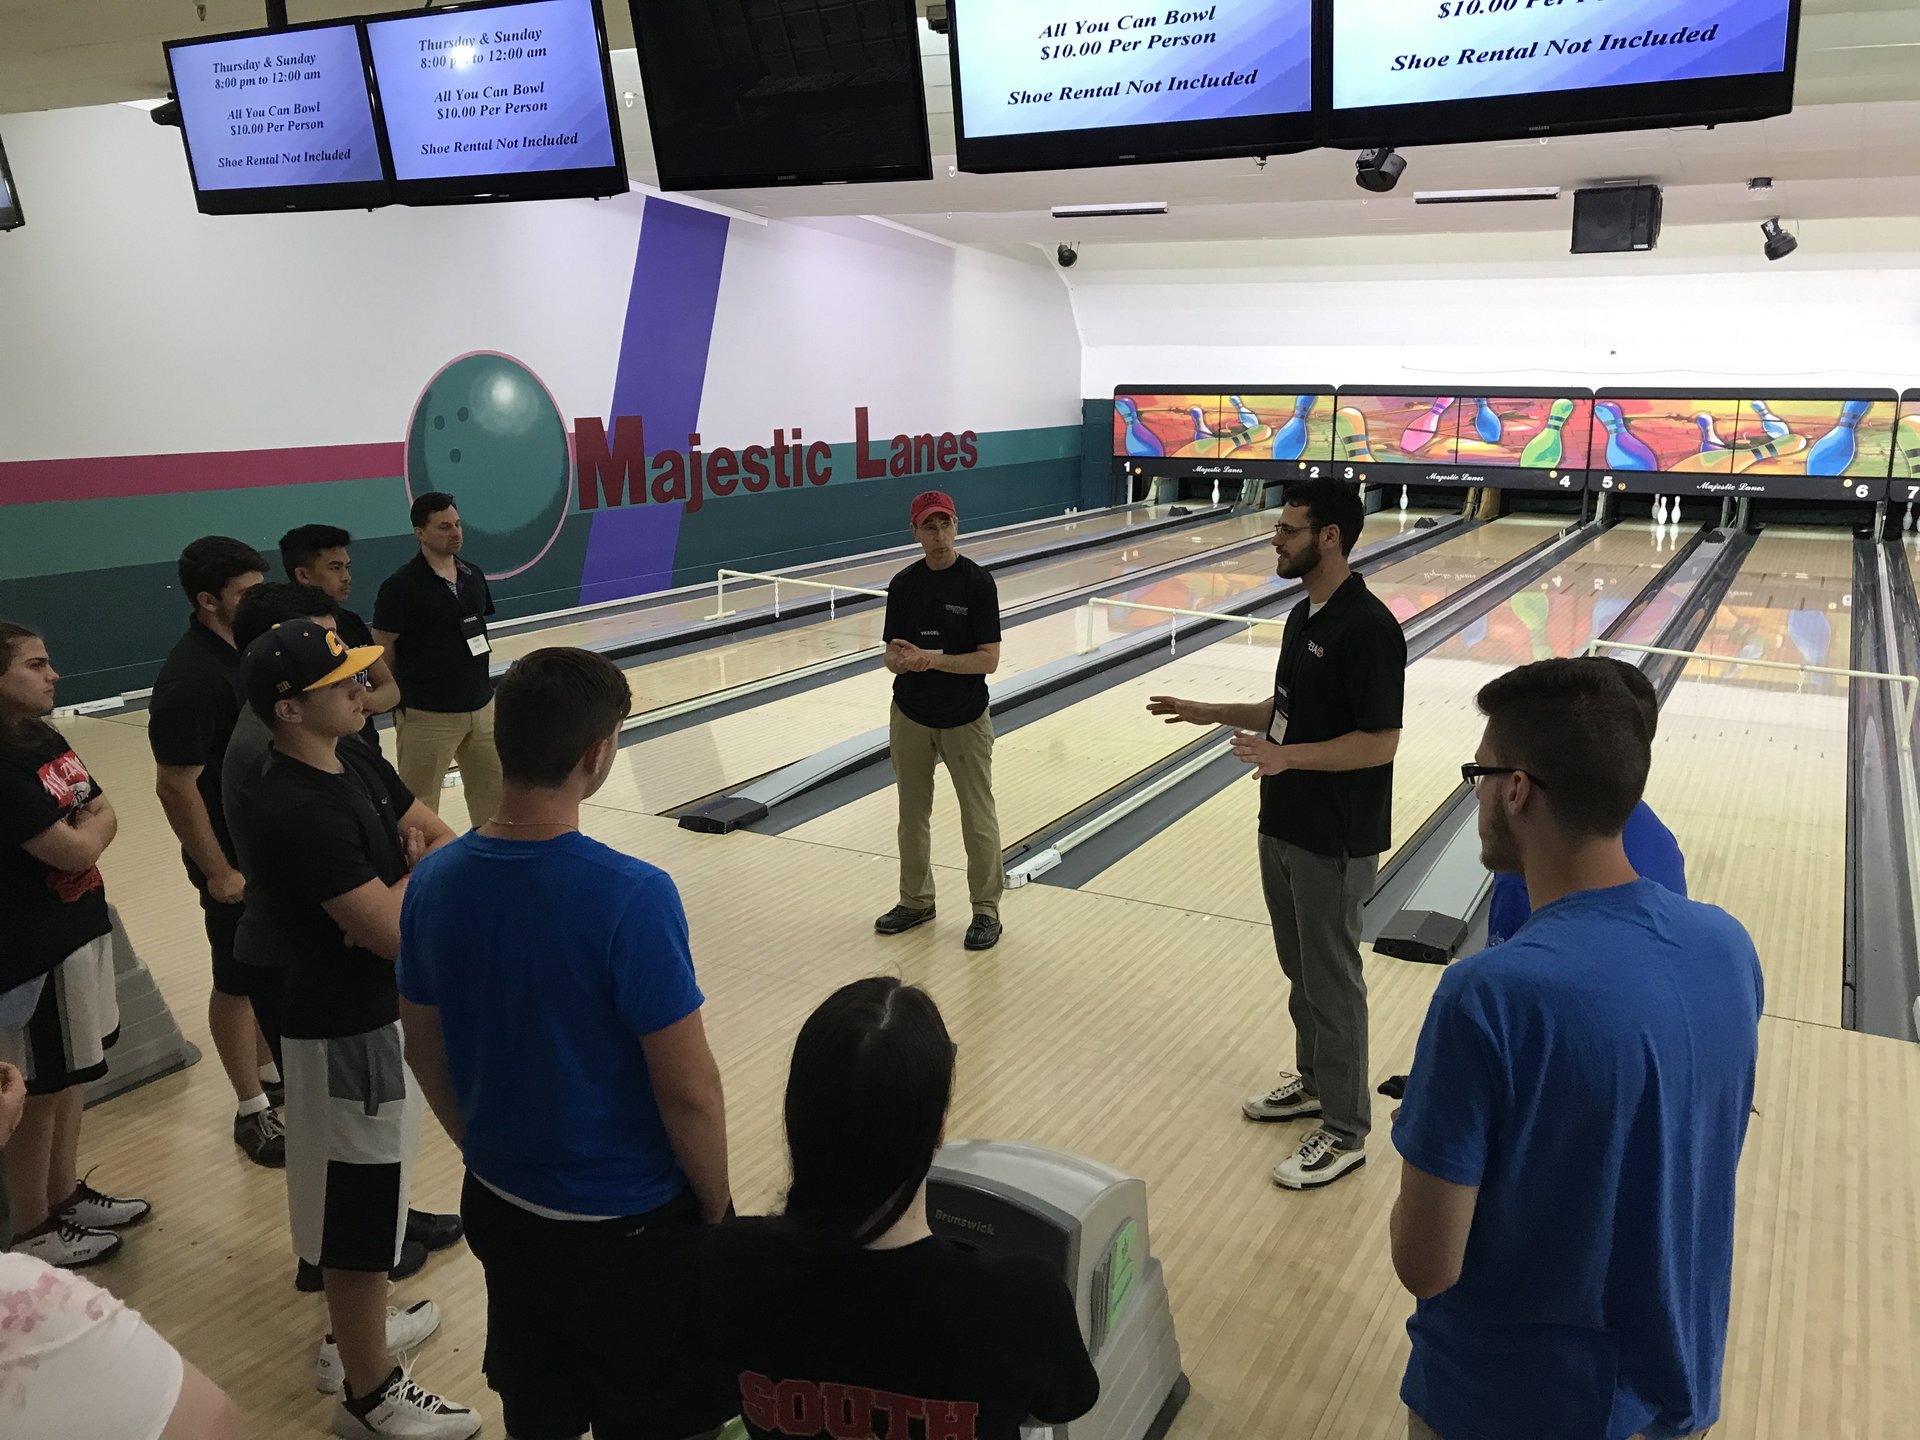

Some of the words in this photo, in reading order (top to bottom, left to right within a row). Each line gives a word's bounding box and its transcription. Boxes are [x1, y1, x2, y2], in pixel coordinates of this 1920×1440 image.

[1438, 0, 1517, 19] $10.00
[1038, 24, 1067, 40] All
[1074, 20, 1110, 35] You
[1117, 15, 1157, 31] Can
[1164, 5, 1216, 25] Bowl
[418, 35, 476, 51] Thursday
[479, 33, 490, 45] &
[494, 28, 542, 43] Sunday
[1040, 40, 1102, 61] $10.00
[1108, 37, 1143, 53] Per
[1147, 30, 1218, 50] Person
[1390, 55, 1451, 72] Shoe
[1457, 42, 1538, 65] Rental
[1544, 37, 1593, 58] Not
[1598, 24, 1719, 51] Included
[213, 59, 260, 74] Thursday
[263, 57, 272, 68] &
[276, 53, 316, 67] Sunday
[420, 55, 446, 69] 8:00
[472, 54, 484, 64] to
[489, 47, 523, 62] 12:00
[527, 47, 547, 58] am
[215, 77, 237, 89] 8:00
[240, 78, 256, 90] pm
[258, 75, 268, 85] to
[272, 70, 301, 83] 12:00
[304, 70, 321, 80] am
[1007, 88, 1053, 106] Shoe
[1058, 81, 1121, 101] Rental
[1125, 78, 1163, 95] Not
[1167, 69, 1259, 92] Included
[433, 90, 452, 103] All
[455, 89, 479, 101] You
[483, 86, 508, 99] Can
[513, 81, 545, 96] Bowl
[227, 109, 242, 120] All
[246, 107, 265, 118] You
[268, 105, 290, 116] Can
[294, 101, 320, 114] Bowl
[437, 105, 476, 120] $10.00
[480, 104, 501, 116] Per
[505, 101, 548, 114] Person
[230, 123, 263, 136] $10.00
[267, 122, 285, 133] Per
[288, 119, 324, 131] Person
[420, 143, 450, 155] Shoe
[454, 139, 492, 152] Rental
[496, 138, 518, 150] Not
[522, 132, 578, 148] Included
[218, 156, 243, 168] Shoe
[246, 154, 279, 166] Rental
[282, 152, 301, 164] Not
[304, 149, 351, 162] Included
[574, 415, 832, 513] Majestic
[854, 406, 979, 480] Lanes
[1123, 461, 1131, 472] 1
[1192, 465, 1221, 474] Majestic
[1223, 465, 1243, 473] Lanes
[1309, 467, 1320, 478] 2
[1343, 466, 1354, 479] 3
[1425, 472, 1460, 483] Majestic
[1461, 472, 1485, 482] Lanes
[1559, 474, 1571, 488] 4
[1602, 475, 1613, 489] 5
[1696, 480, 1736, 492] Majestic
[1738, 482, 1765, 492] Lanes
[1855, 484, 1869, 498] 6
[1907, 485, 1920, 499] 7
[935, 1208, 995, 1236] Brunswick
[738, 1370, 980, 1440] SOUTH
